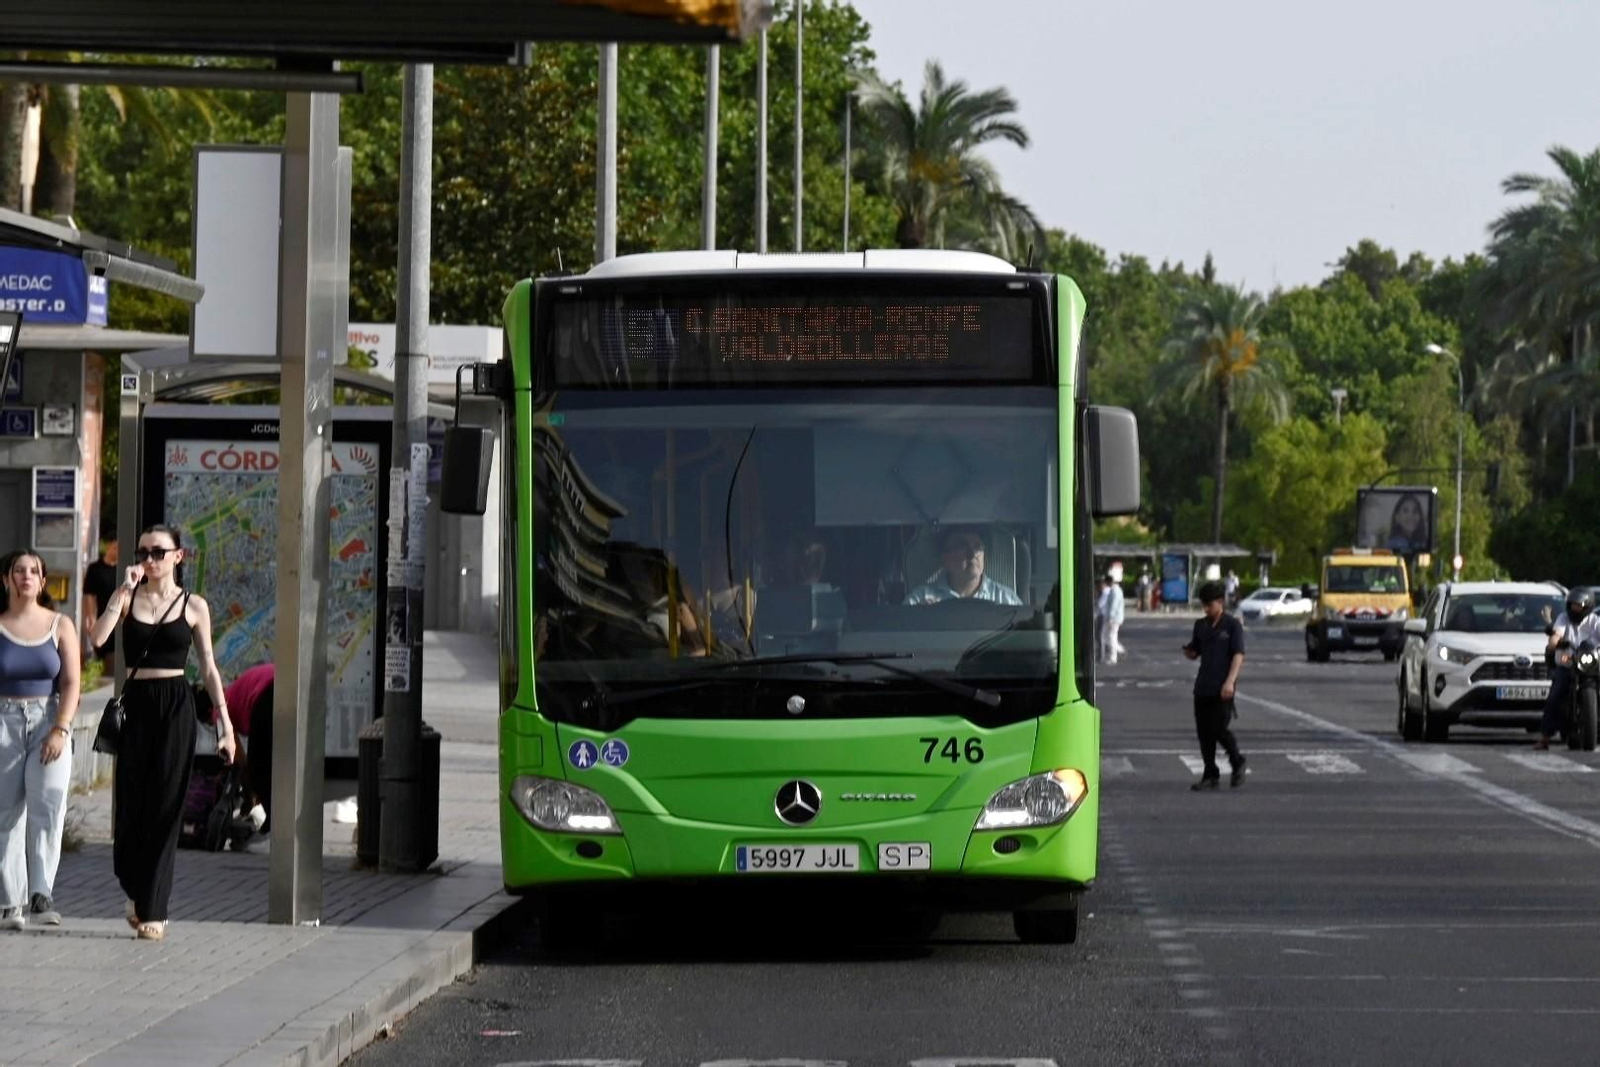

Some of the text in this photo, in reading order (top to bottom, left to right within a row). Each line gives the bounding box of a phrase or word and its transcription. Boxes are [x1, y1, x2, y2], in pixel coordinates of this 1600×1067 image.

[721, 335, 949, 360] VALDEOLLEROS
[251, 423, 280, 434] JCDec
[200, 443, 342, 472] CÓRD
[919, 737, 984, 764] 746
[751, 848, 854, 868] 5997 JJL
